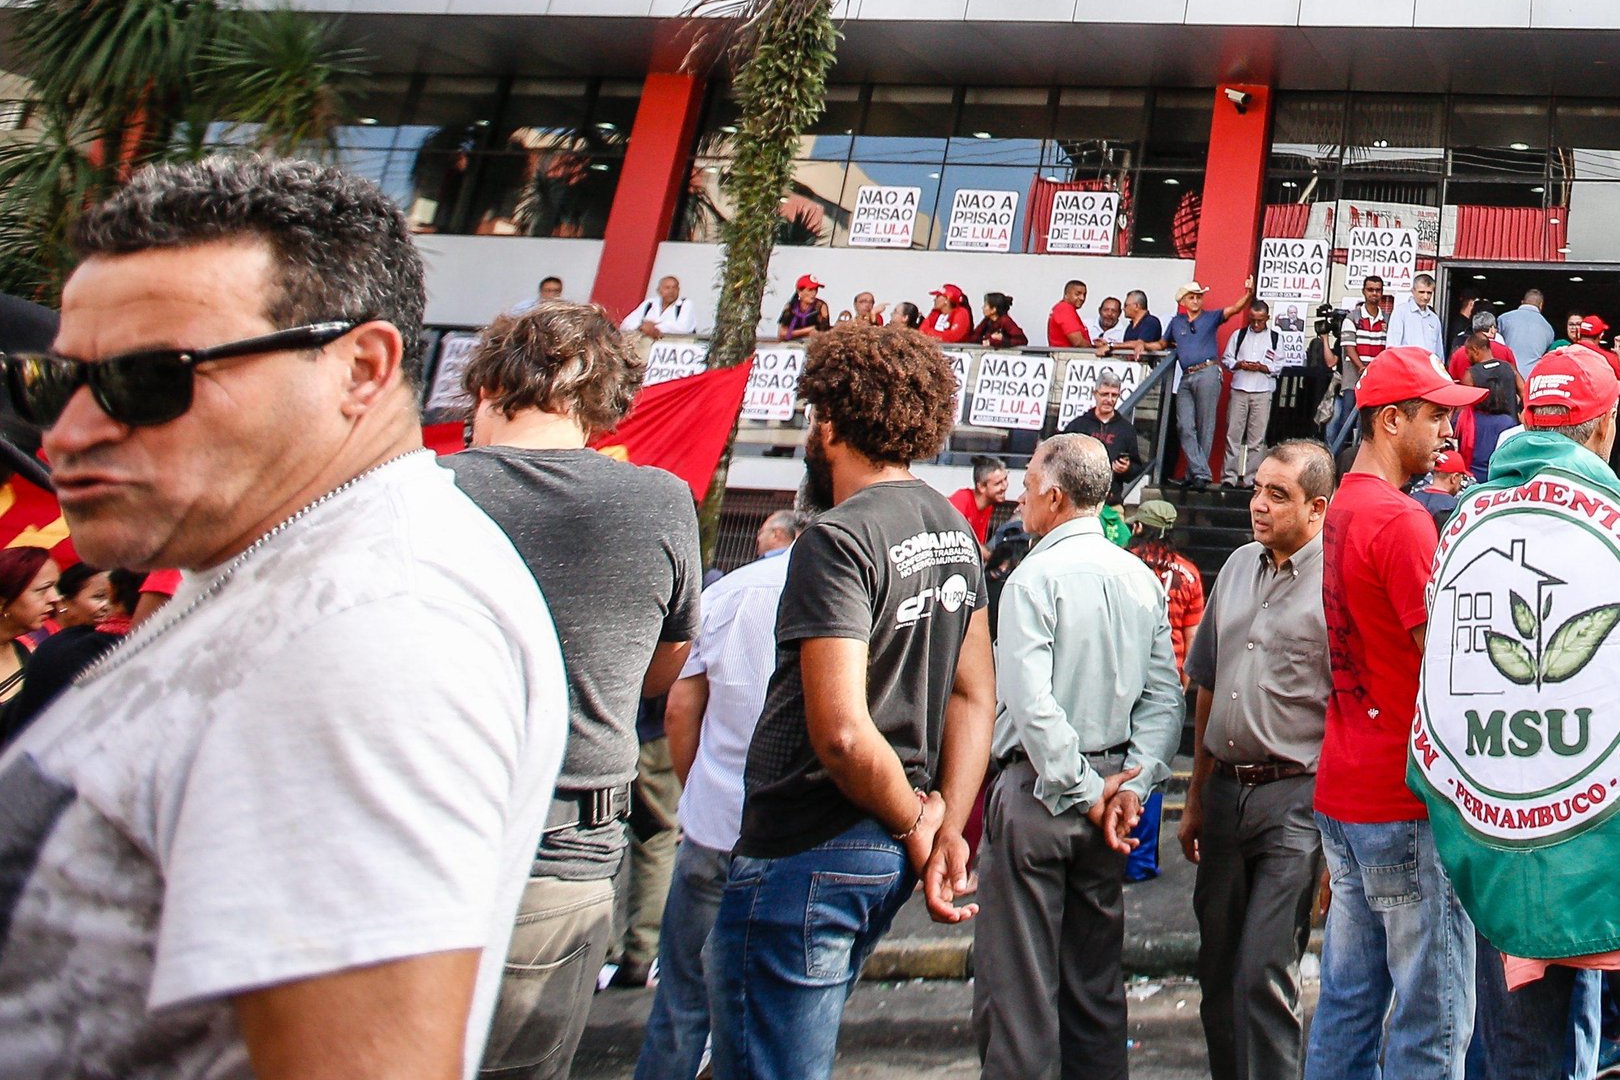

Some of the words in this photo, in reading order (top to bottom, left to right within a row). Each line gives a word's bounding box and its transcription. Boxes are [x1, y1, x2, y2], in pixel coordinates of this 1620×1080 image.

[853, 222, 872, 234] DE
[874, 223, 910, 236] LULA
[950, 226, 968, 239] DE
[971, 227, 1008, 240] LULA
[1051, 228, 1070, 240] DE
[1073, 228, 1109, 241] LULA
[1349, 264, 1368, 278] DE
[1373, 266, 1410, 279] LULA
[1260, 276, 1279, 289] DE
[1283, 277, 1321, 290] LULA
[750, 392, 790, 406] LULA
[975, 397, 996, 412] DE
[1000, 399, 1041, 416] LULA
[900, 567, 913, 579] NO
[1465, 707, 1593, 758] MSU
[1455, 783, 1607, 830] PERNAMBUCO
